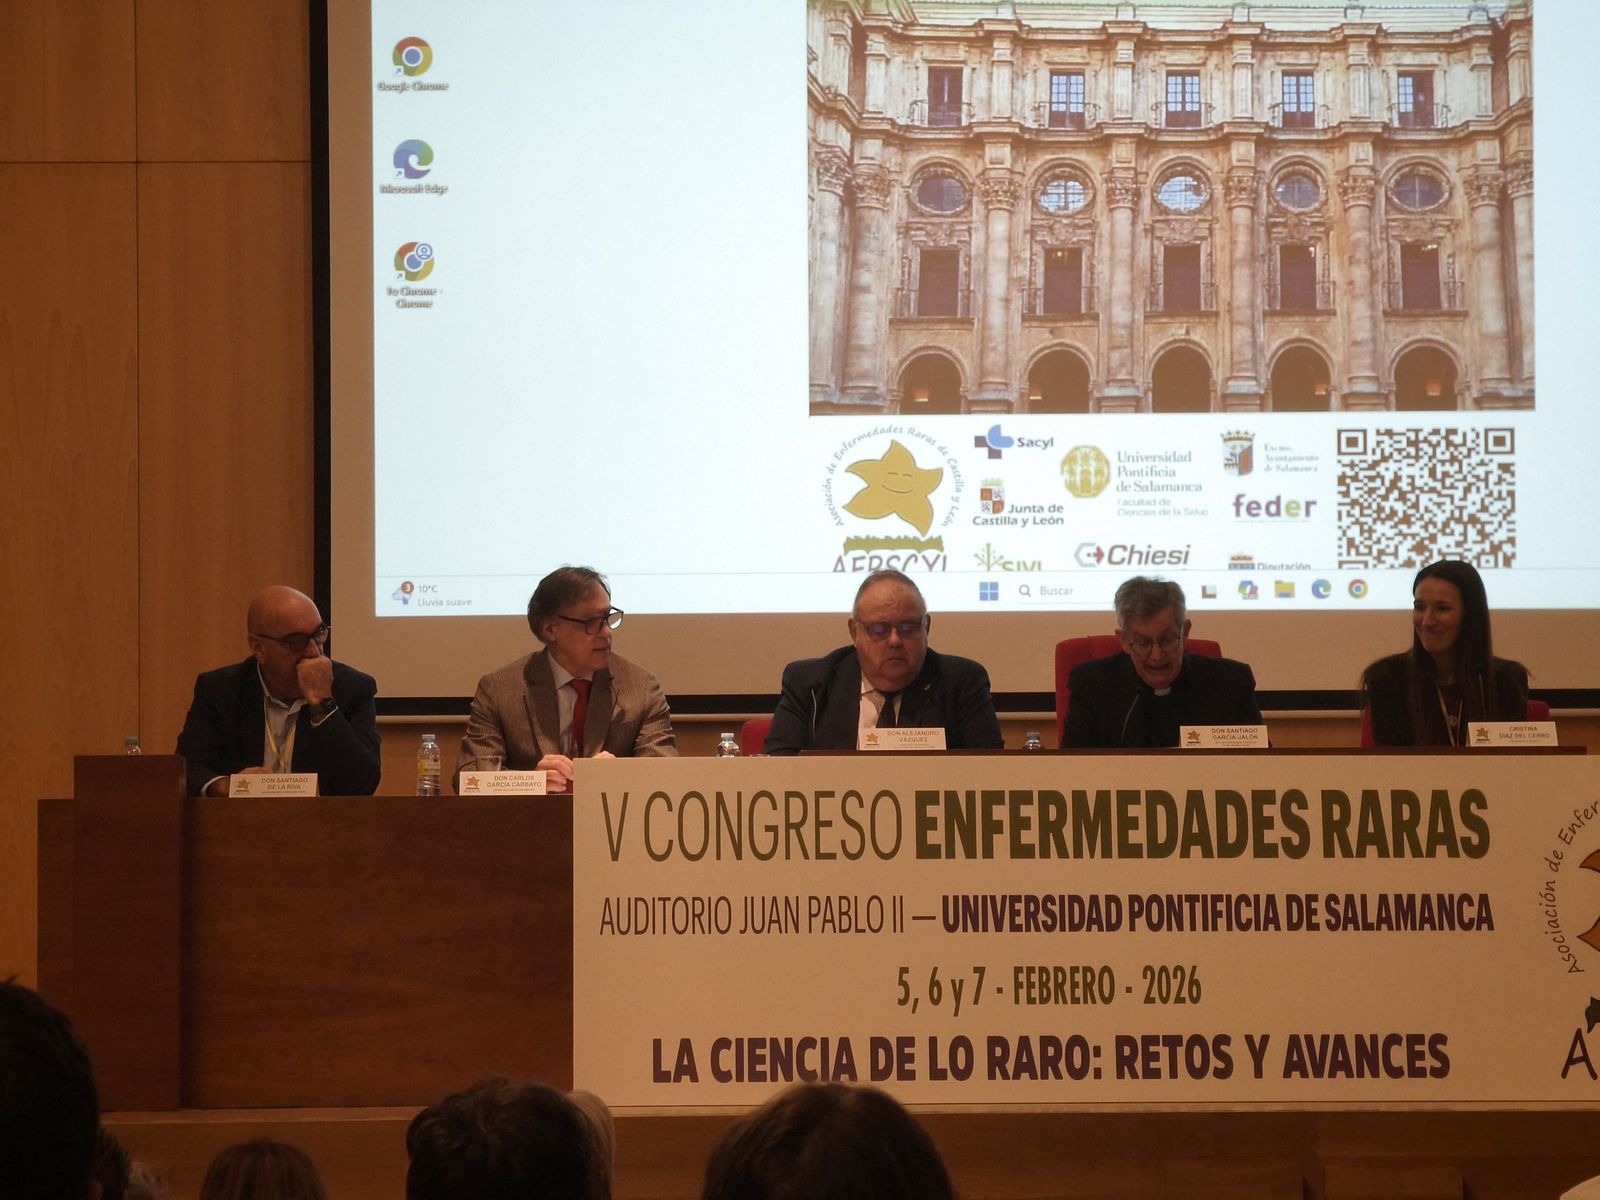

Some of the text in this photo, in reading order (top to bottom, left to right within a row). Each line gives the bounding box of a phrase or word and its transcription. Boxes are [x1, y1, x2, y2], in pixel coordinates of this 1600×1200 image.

[377, 80, 449, 94] Google Chrome
[834, 424, 903, 460] Enfermedades
[907, 427, 936, 446] Raras
[1017, 437, 1054, 450] Sacyl
[937, 445, 949, 456] de
[1117, 450, 1192, 463] Universidad
[826, 463, 837, 474] de
[947, 458, 964, 493] Castilla
[1117, 465, 1176, 477] Pontificia
[1116, 480, 1203, 492] de Salamanca
[822, 478, 844, 526] Asociación
[1008, 503, 1064, 514] Junta de
[1117, 498, 1171, 506] Facultad de
[1232, 494, 1317, 518] feder
[972, 515, 1064, 528] Castilla y León
[1107, 544, 1191, 565] Chiesi
[1040, 586, 1074, 596] Buscar
[417, 598, 472, 607] Lluvia suave
[600, 788, 1491, 862] V CONGRESO ENFERMEDADES RARAS
[1539, 801, 1598, 973] Asociación de Enfer
[600, 895, 732, 936] AUDITORIO
[739, 895, 800, 935] JUAN
[808, 895, 885, 935] PABLO
[892, 895, 904, 934] II
[942, 894, 1124, 933] UNIVERSIDAD
[1128, 893, 1282, 932] PONTIFICIA
[1286, 893, 1320, 932] DE
[1324, 893, 1496, 932] SALAMANCA
[897, 966, 919, 1015] 5,
[928, 966, 943, 1007] 6
[950, 978, 965, 1018] y
[972, 966, 987, 1006] 7
[1013, 965, 1116, 1006] FEBRERO
[1141, 964, 1202, 1005] 2026
[652, 1033, 1451, 1084] LA CIENCIA DE LO RARO: RETOS Y AVANCES
